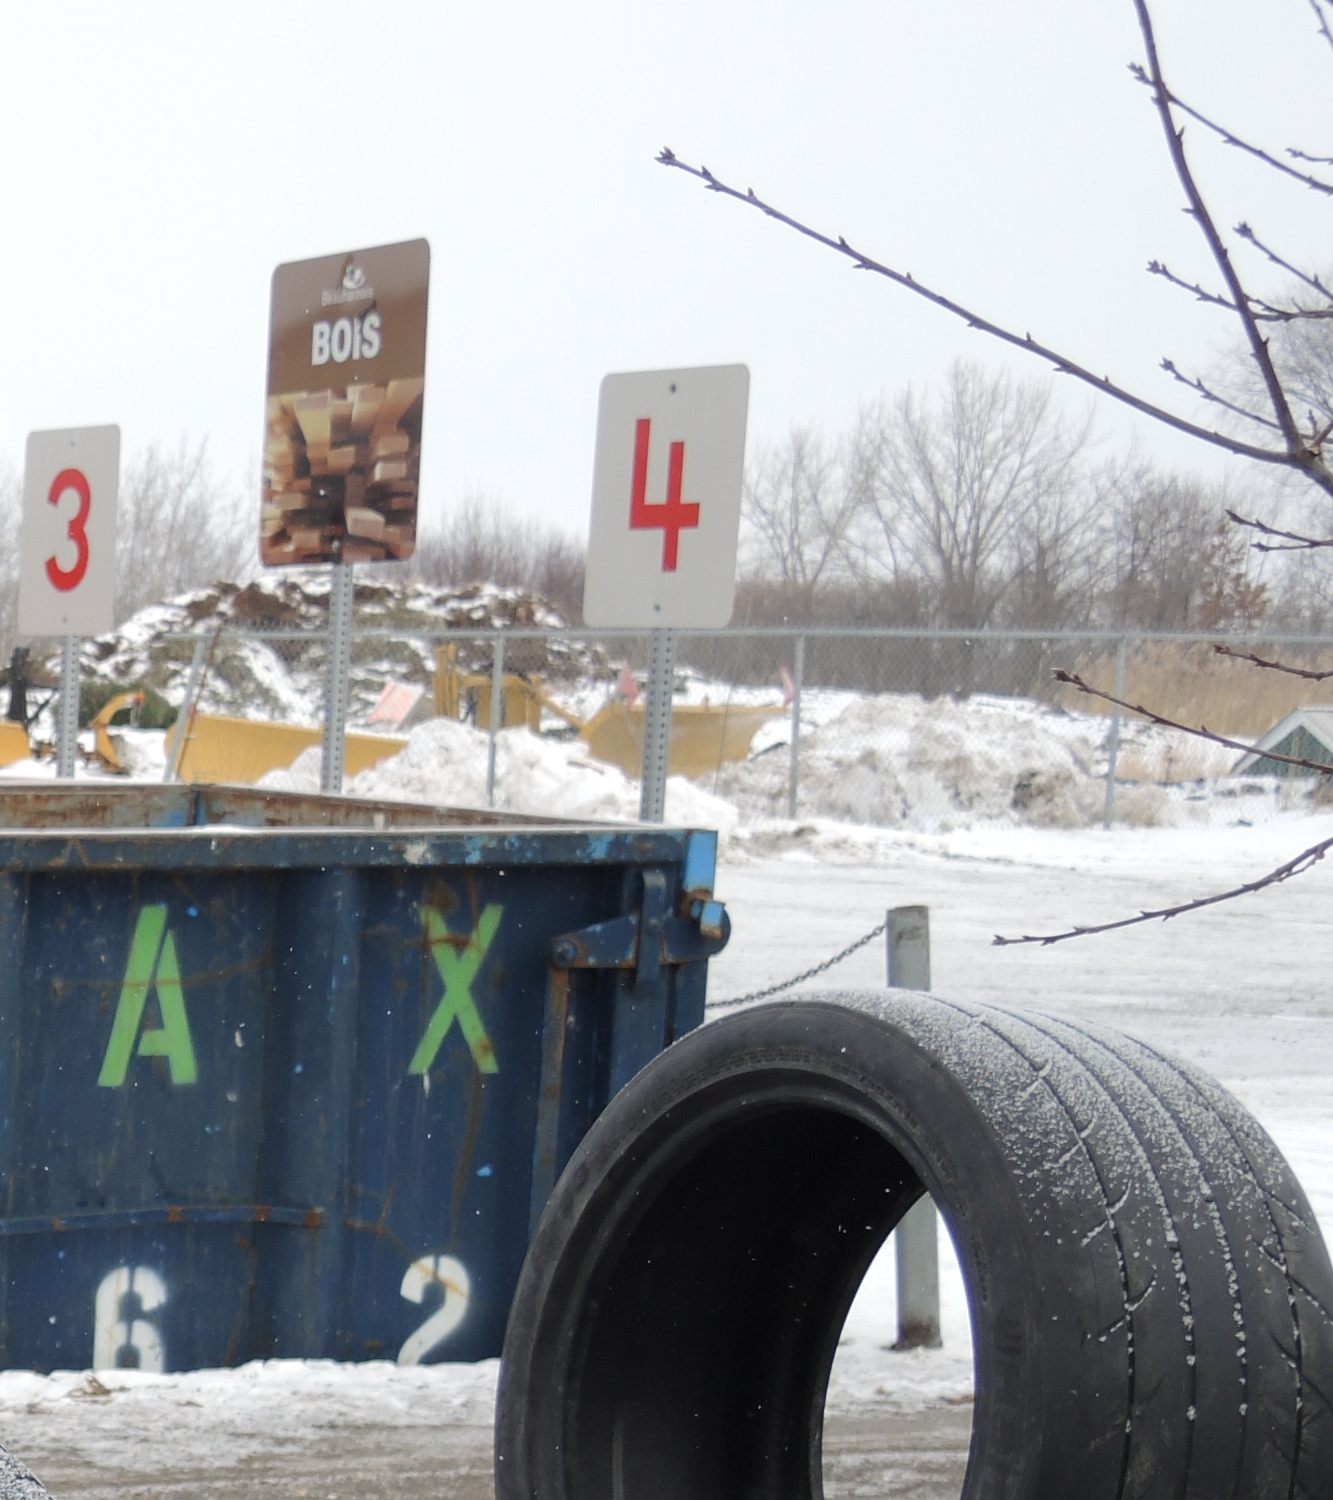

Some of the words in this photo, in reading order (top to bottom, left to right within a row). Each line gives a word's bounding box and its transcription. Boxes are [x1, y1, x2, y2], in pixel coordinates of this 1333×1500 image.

[311, 311, 383, 366] BOIS
[45, 467, 91, 592] 3
[630, 418, 700, 572] 4
